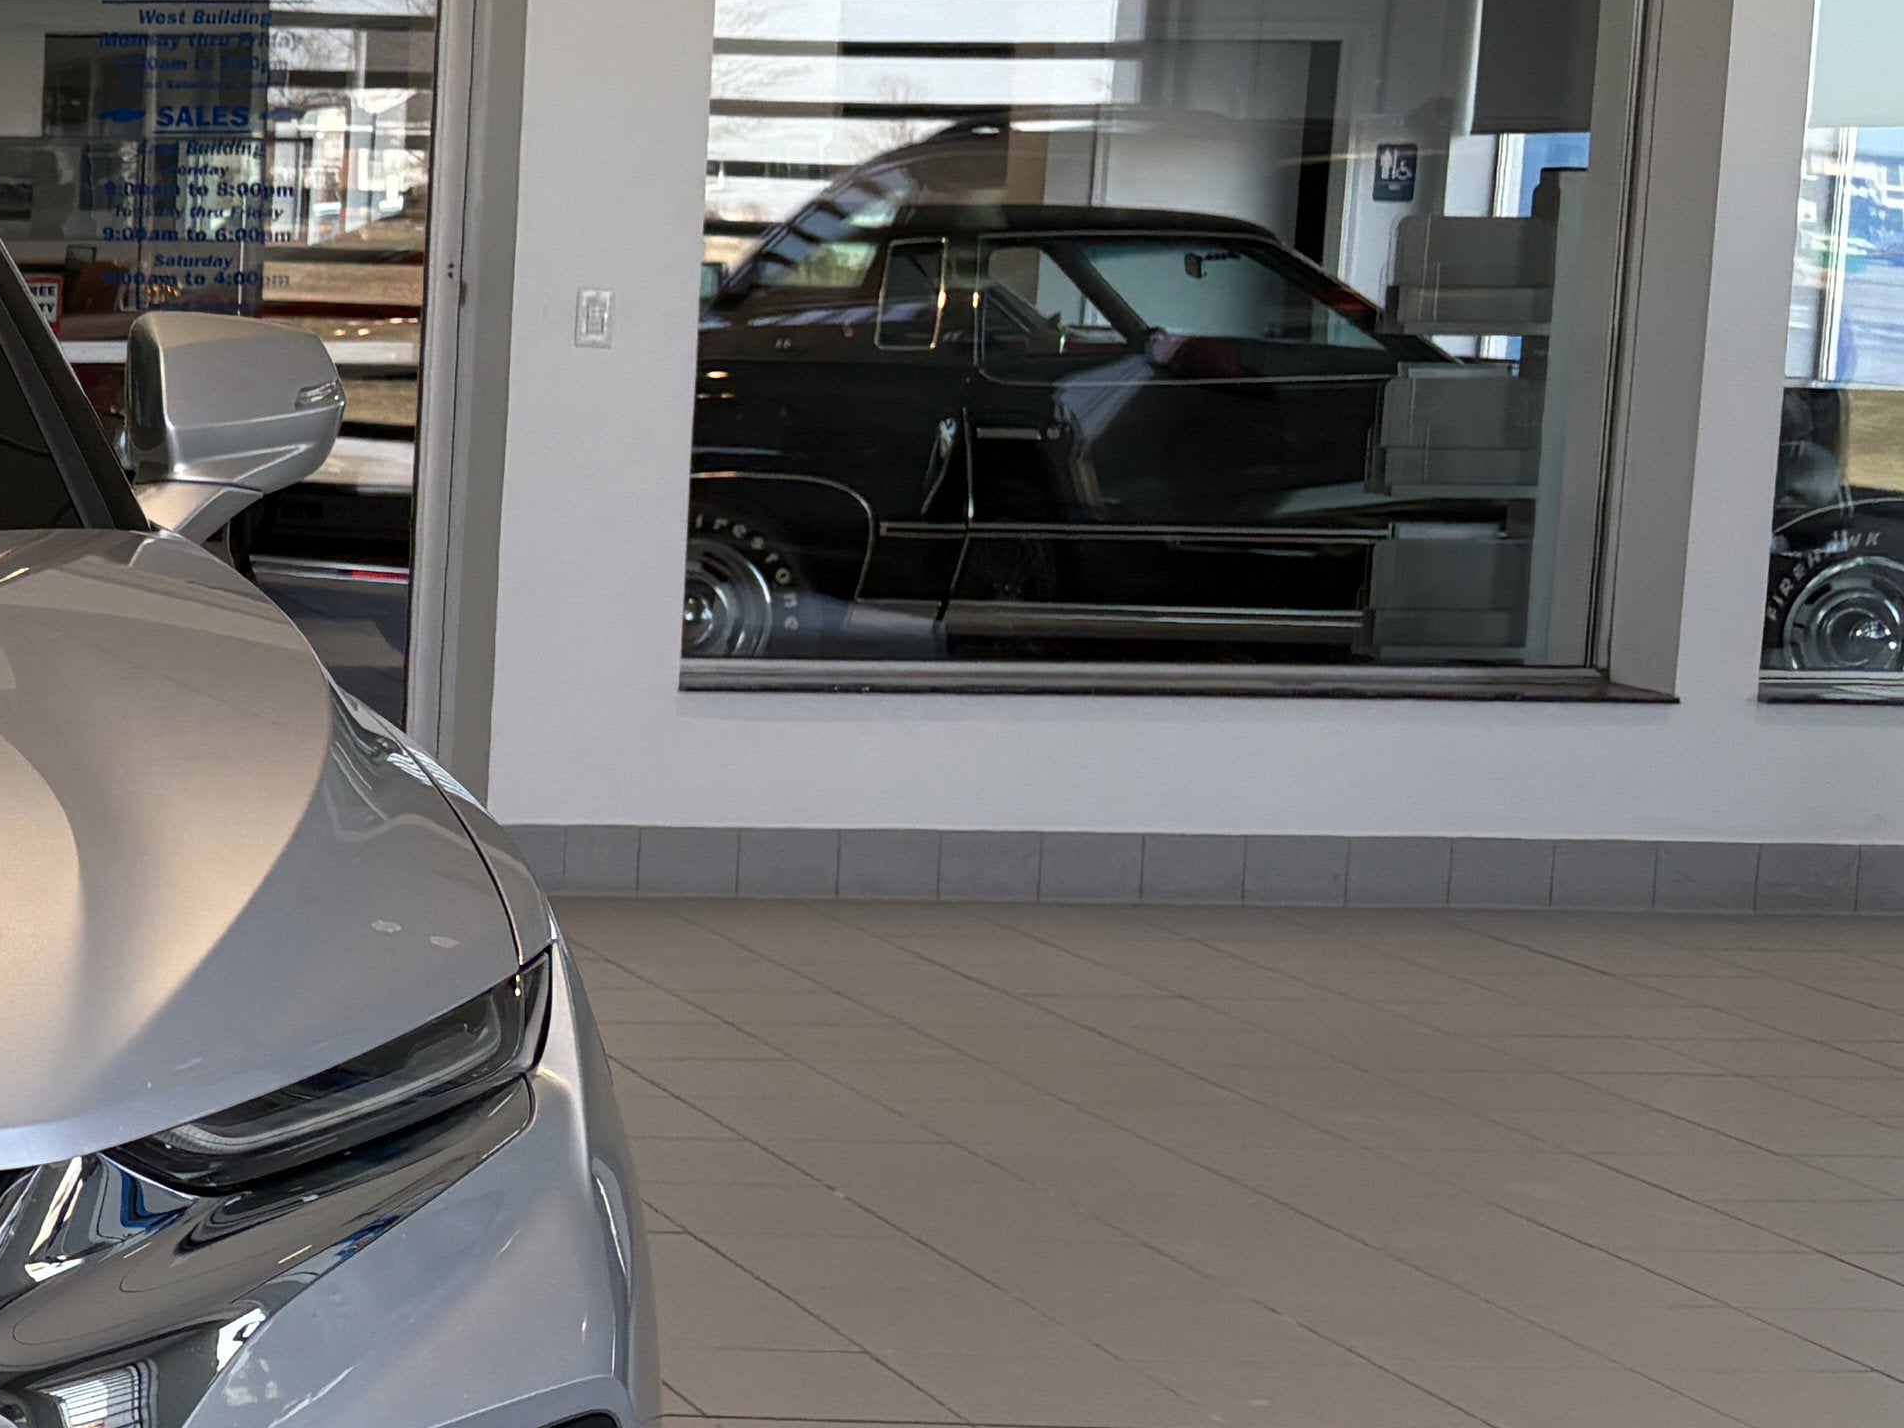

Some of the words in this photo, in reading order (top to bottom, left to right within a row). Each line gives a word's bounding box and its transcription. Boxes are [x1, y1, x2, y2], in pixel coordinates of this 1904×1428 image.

[138, 9, 187, 25] West
[193, 8, 273, 28] Building
[157, 105, 250, 127] SALES
[188, 182, 208, 198] to
[102, 227, 179, 243] 9:00am
[187, 227, 207, 243] to
[153, 253, 233, 269] Saturday
[185, 270, 206, 286] to
